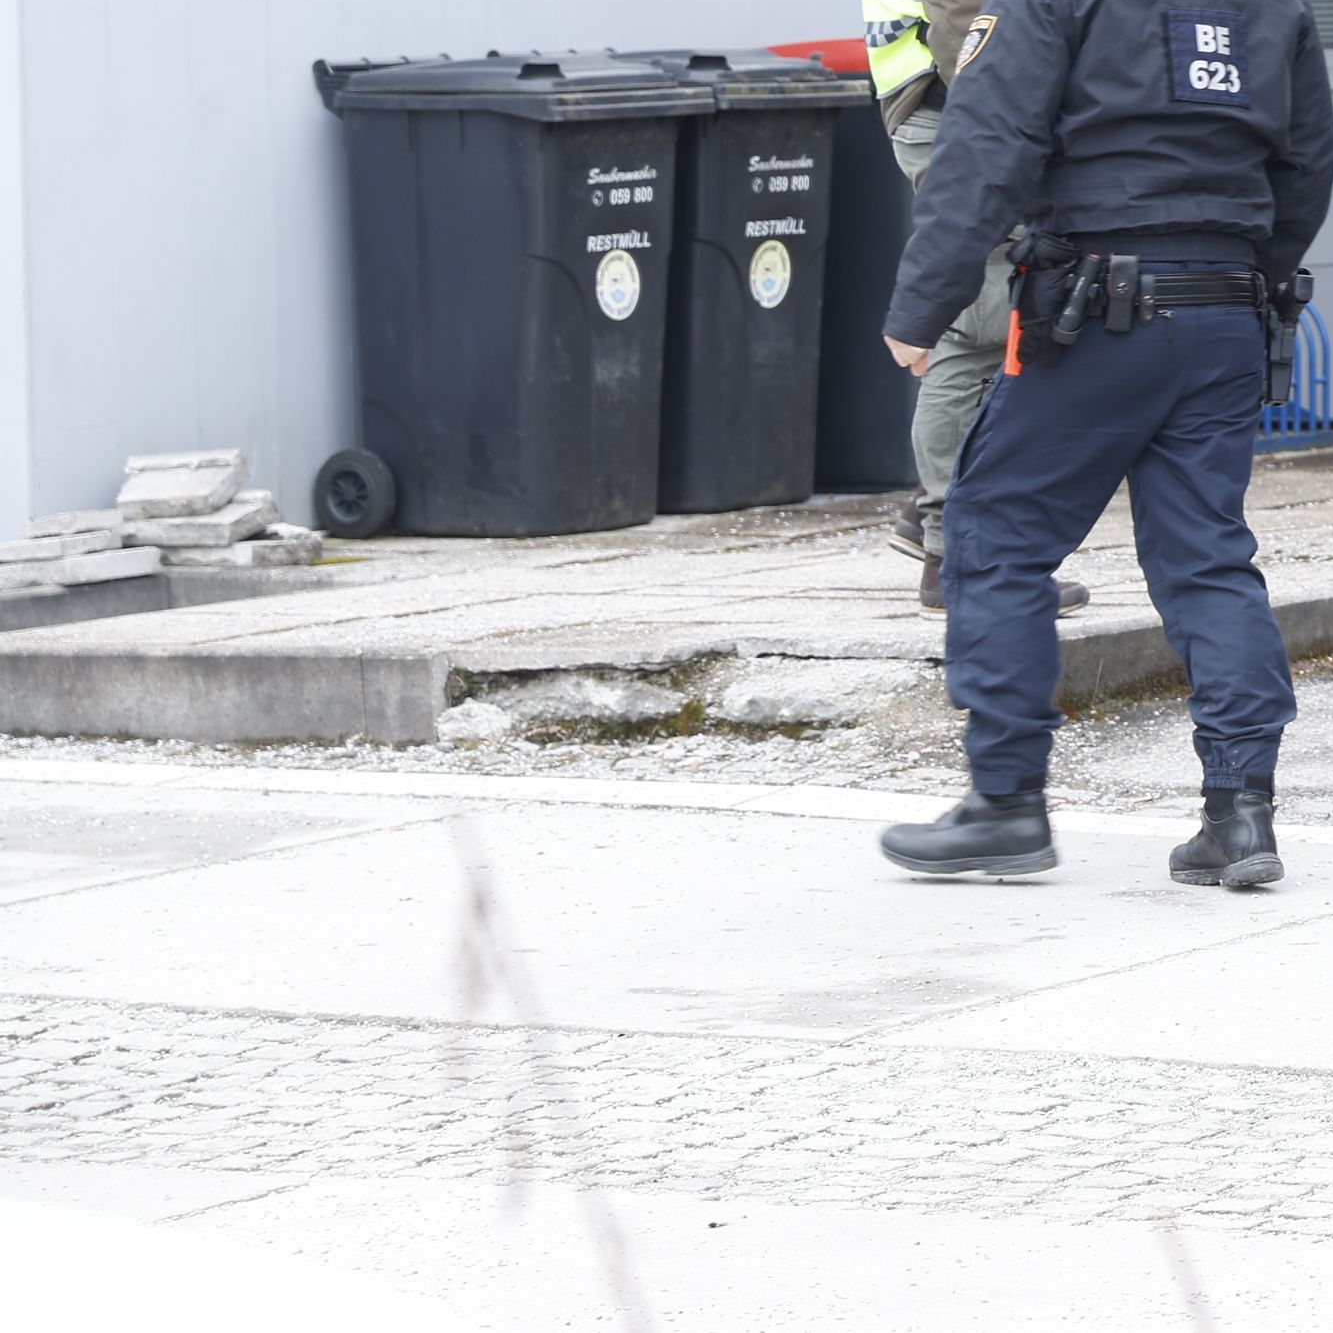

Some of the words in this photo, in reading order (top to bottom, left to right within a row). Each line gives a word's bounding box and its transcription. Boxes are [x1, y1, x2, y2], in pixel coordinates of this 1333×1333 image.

[1195, 24, 1231, 55] BE
[1189, 60, 1241, 93] 623
[609, 187, 631, 205] 059
[745, 217, 807, 238] RESTMÜLL
[586, 229, 652, 253] RESTMÜLL
